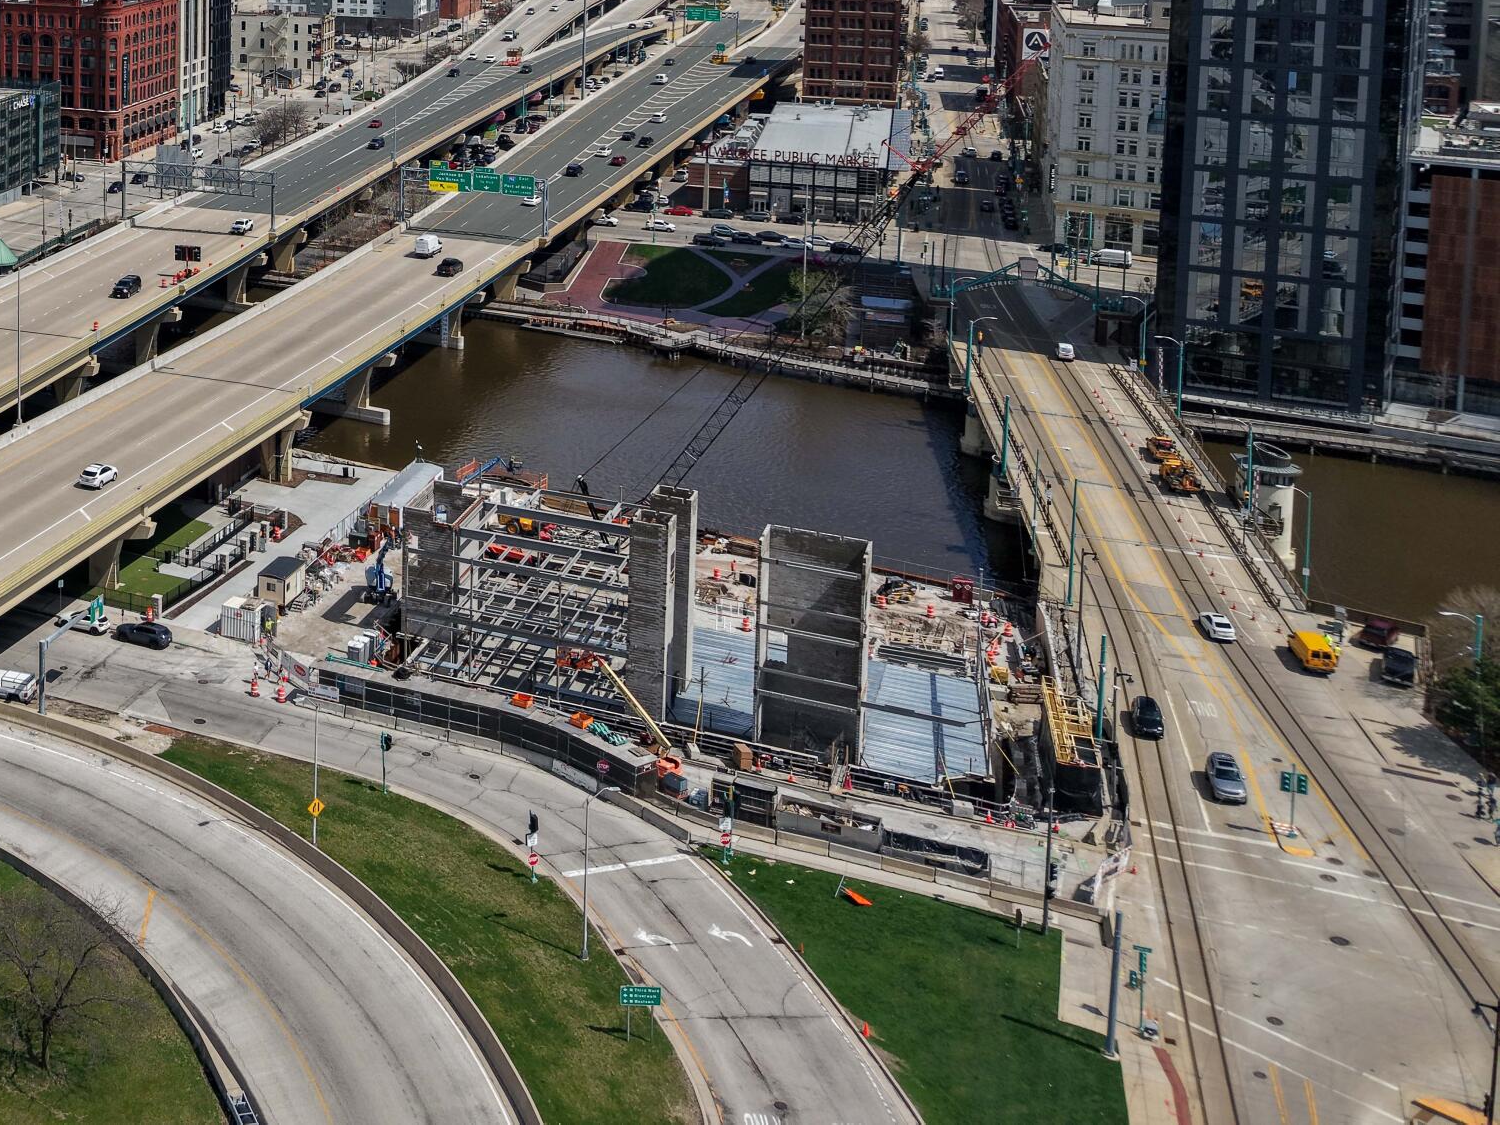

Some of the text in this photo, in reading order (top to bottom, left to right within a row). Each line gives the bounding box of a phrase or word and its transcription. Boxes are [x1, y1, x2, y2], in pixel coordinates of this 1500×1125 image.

[774, 150, 820, 164] PUBLIC
[825, 153, 879, 169] MARKET
[967, 279, 1015, 292] HISTORIC
